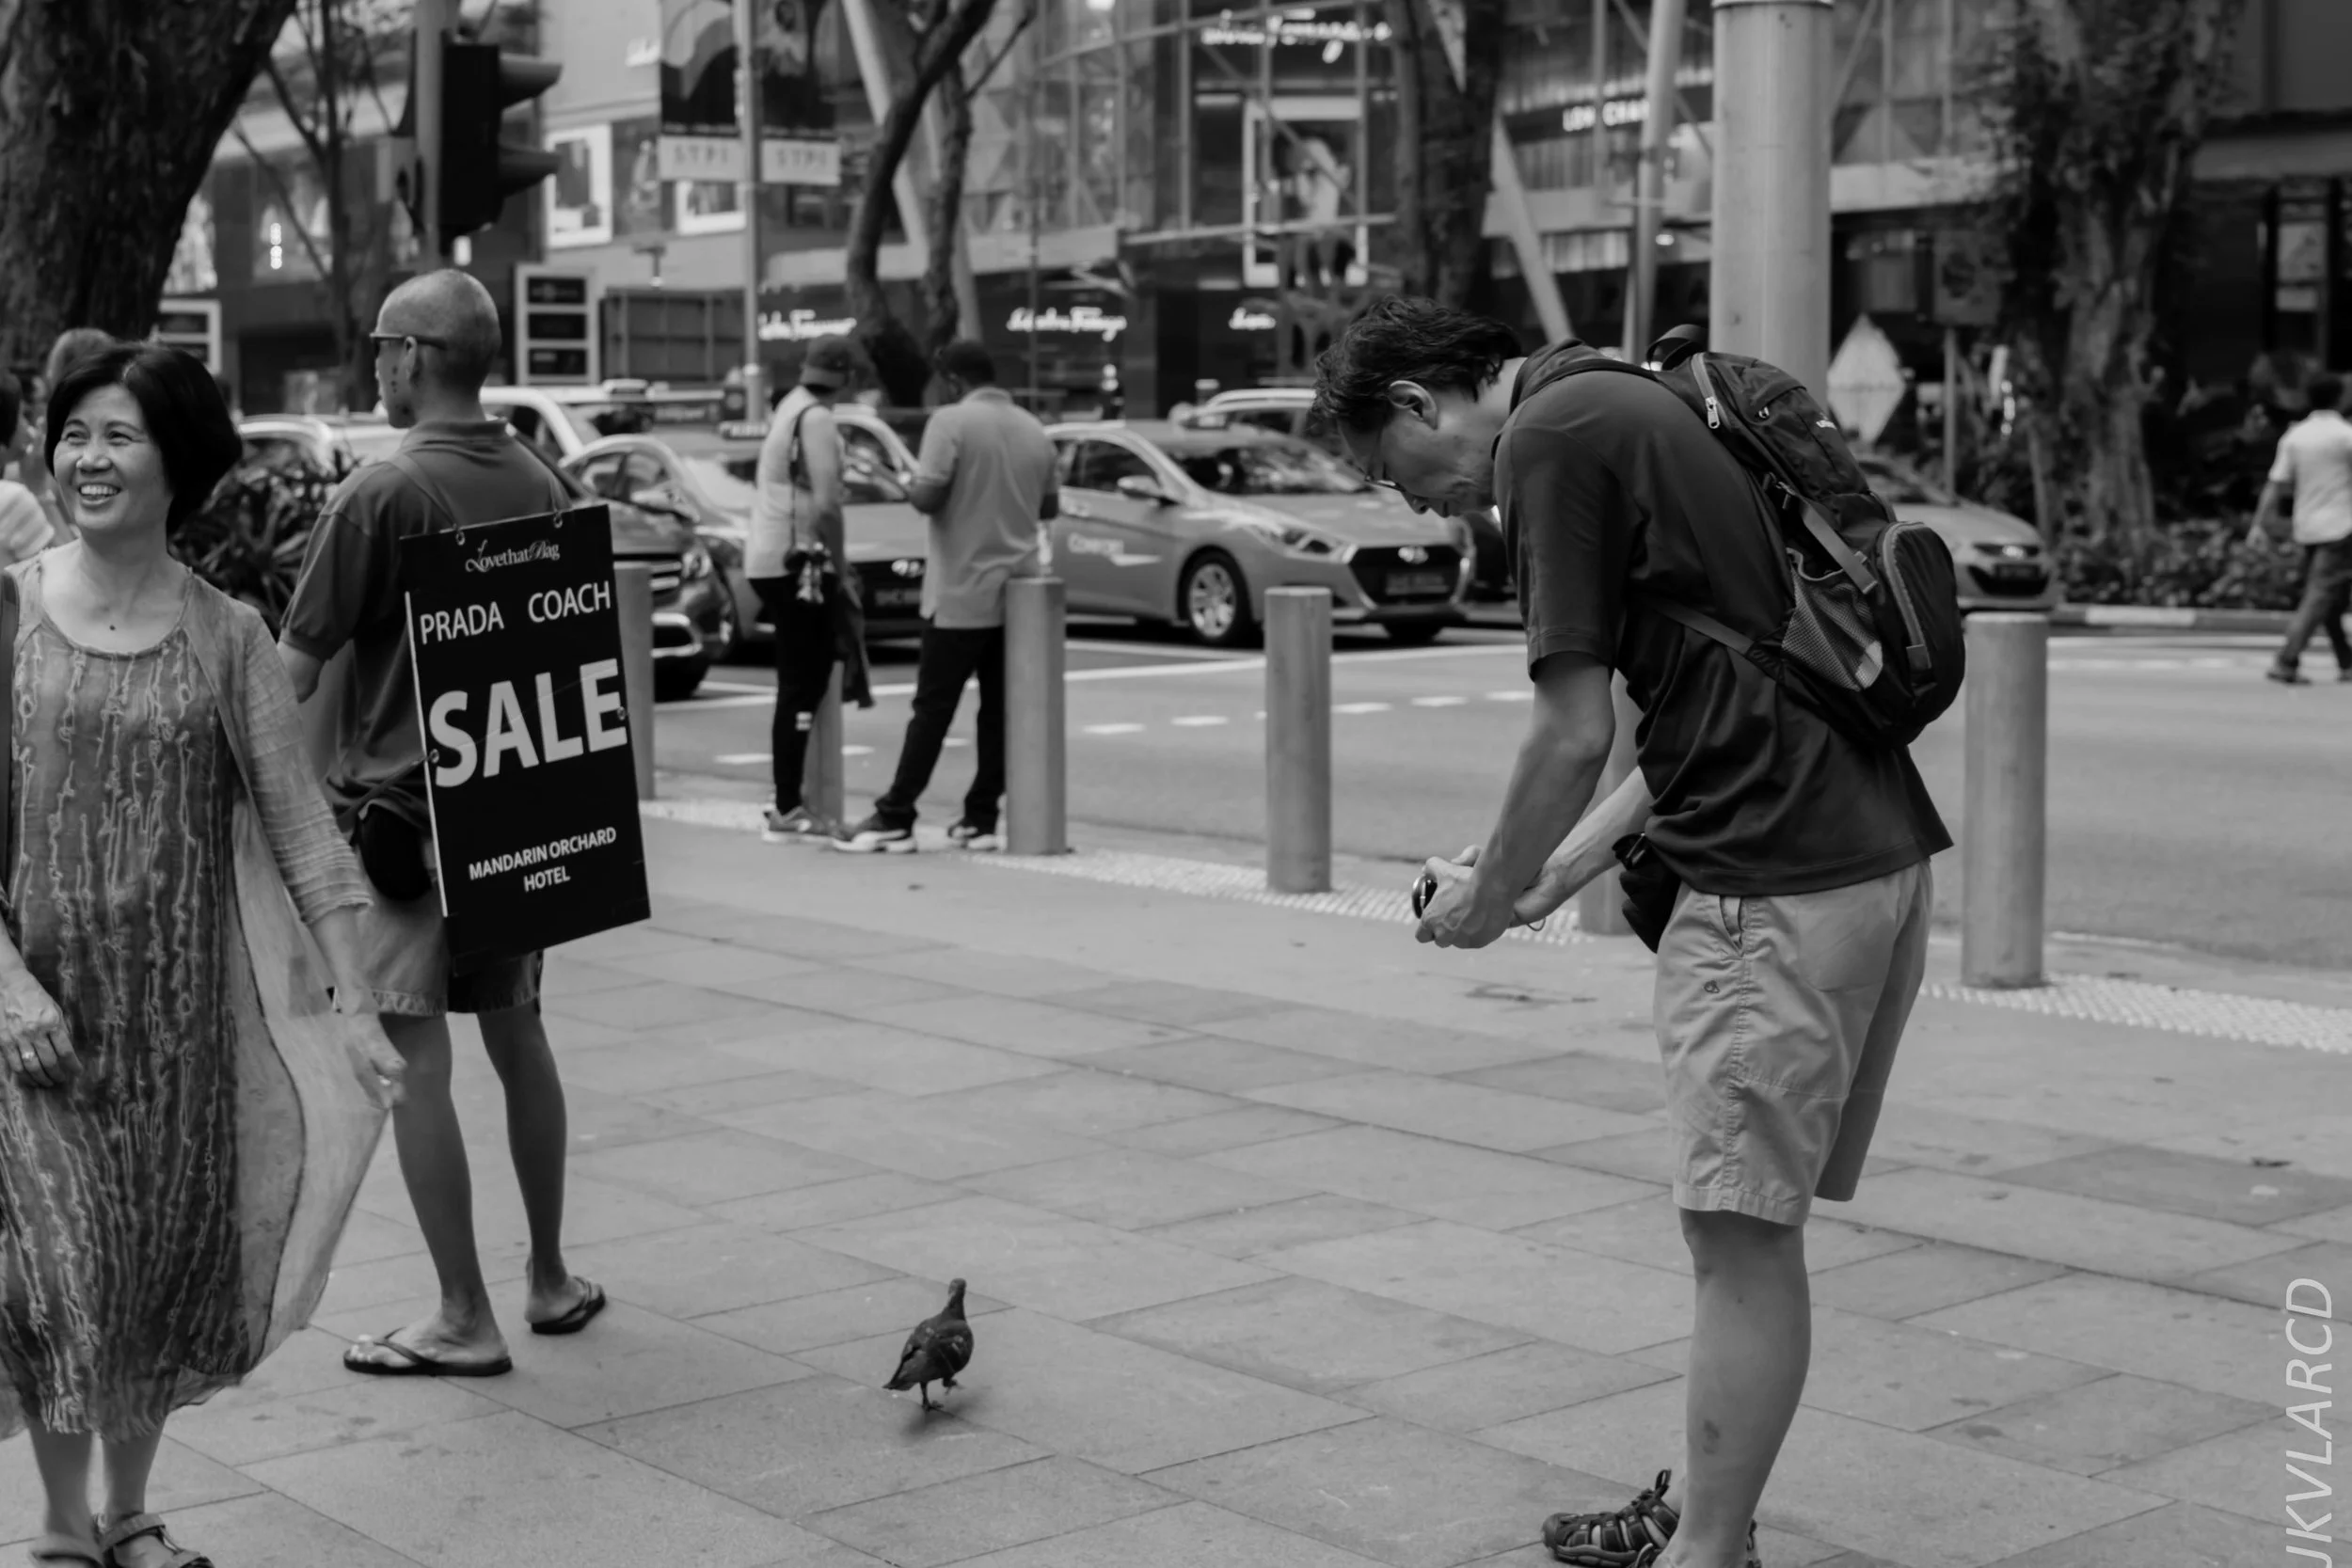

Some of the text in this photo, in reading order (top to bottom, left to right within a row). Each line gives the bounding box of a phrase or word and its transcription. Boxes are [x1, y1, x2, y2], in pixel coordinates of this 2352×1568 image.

[420, 580, 612, 645] PRADA COACH
[428, 658, 628, 788] SALE
[469, 827, 617, 880] MANDARIN ORCHARD
[524, 865, 571, 893] HOTEL
